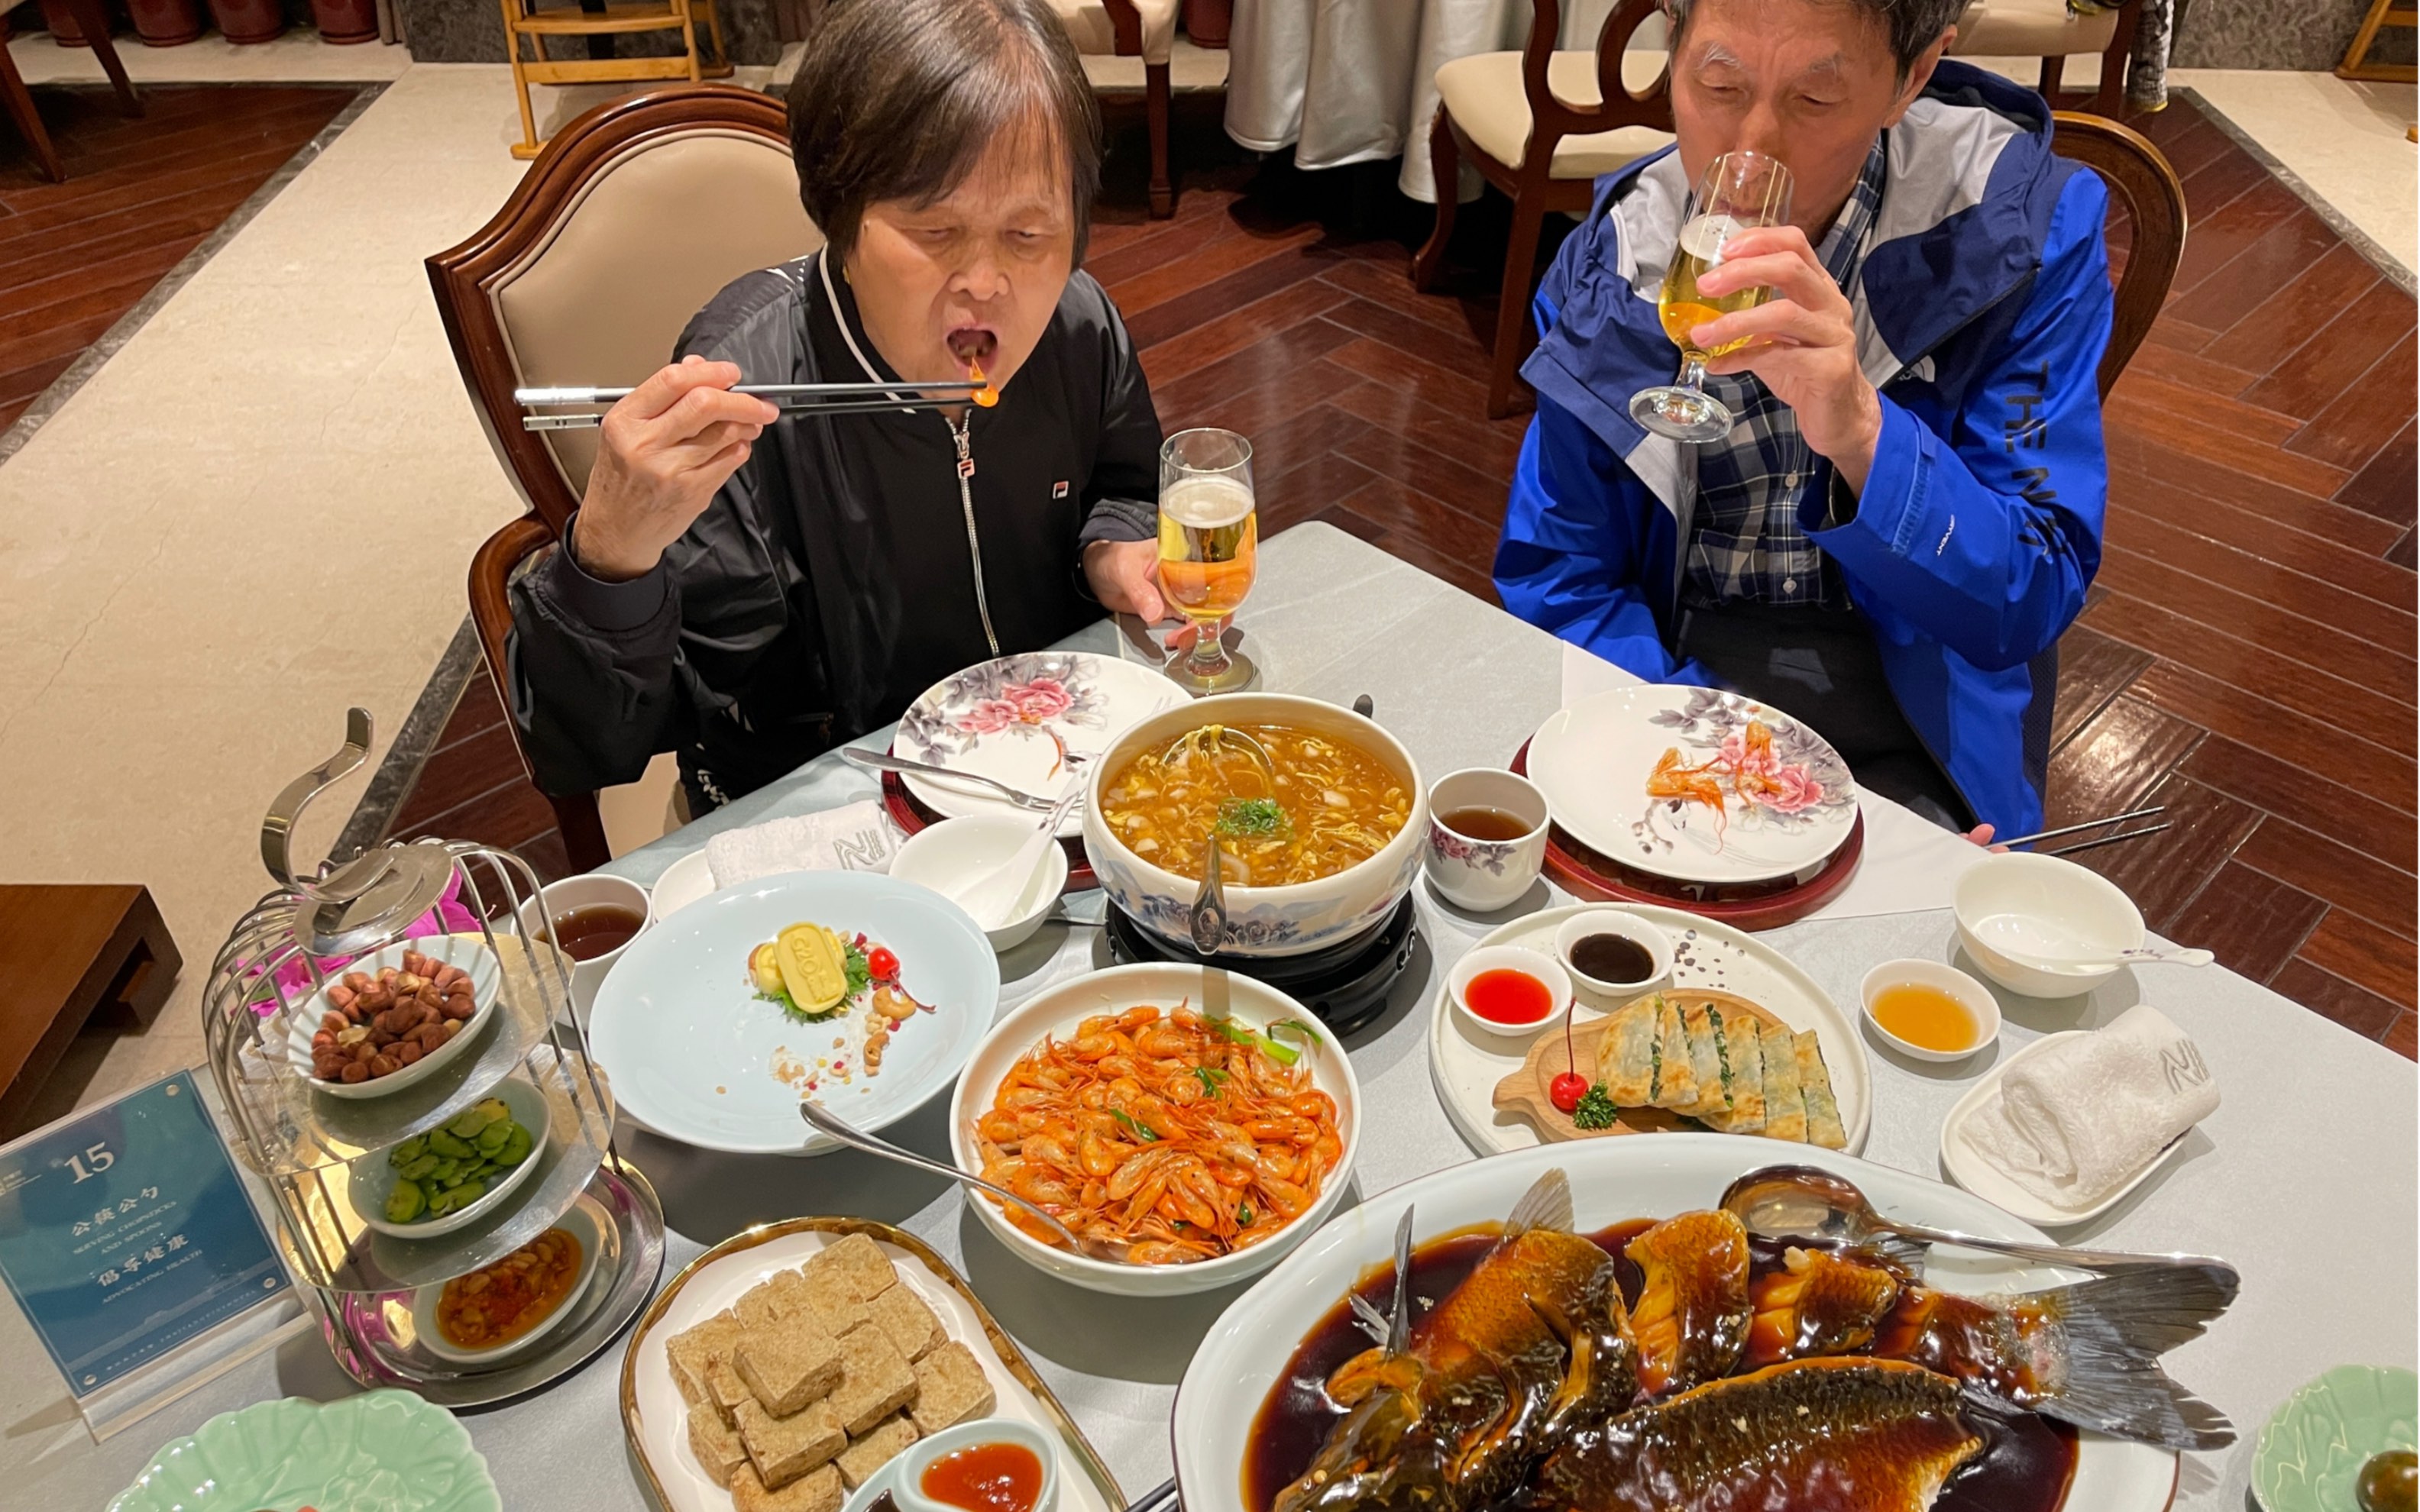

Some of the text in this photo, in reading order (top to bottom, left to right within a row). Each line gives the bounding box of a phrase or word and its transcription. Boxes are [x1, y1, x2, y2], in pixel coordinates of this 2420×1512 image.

[2004, 360, 2049, 452] THE
[64, 1142, 115, 1184] 15
[72, 1186, 158, 1236] 公筷公勺
[73, 1230, 115, 1254] SERVING
[97, 1234, 189, 1287] 倡导健康
[101, 1222, 162, 1255] AND SPOONS
[102, 1249, 202, 1304] ADVOCATING HEALTH
